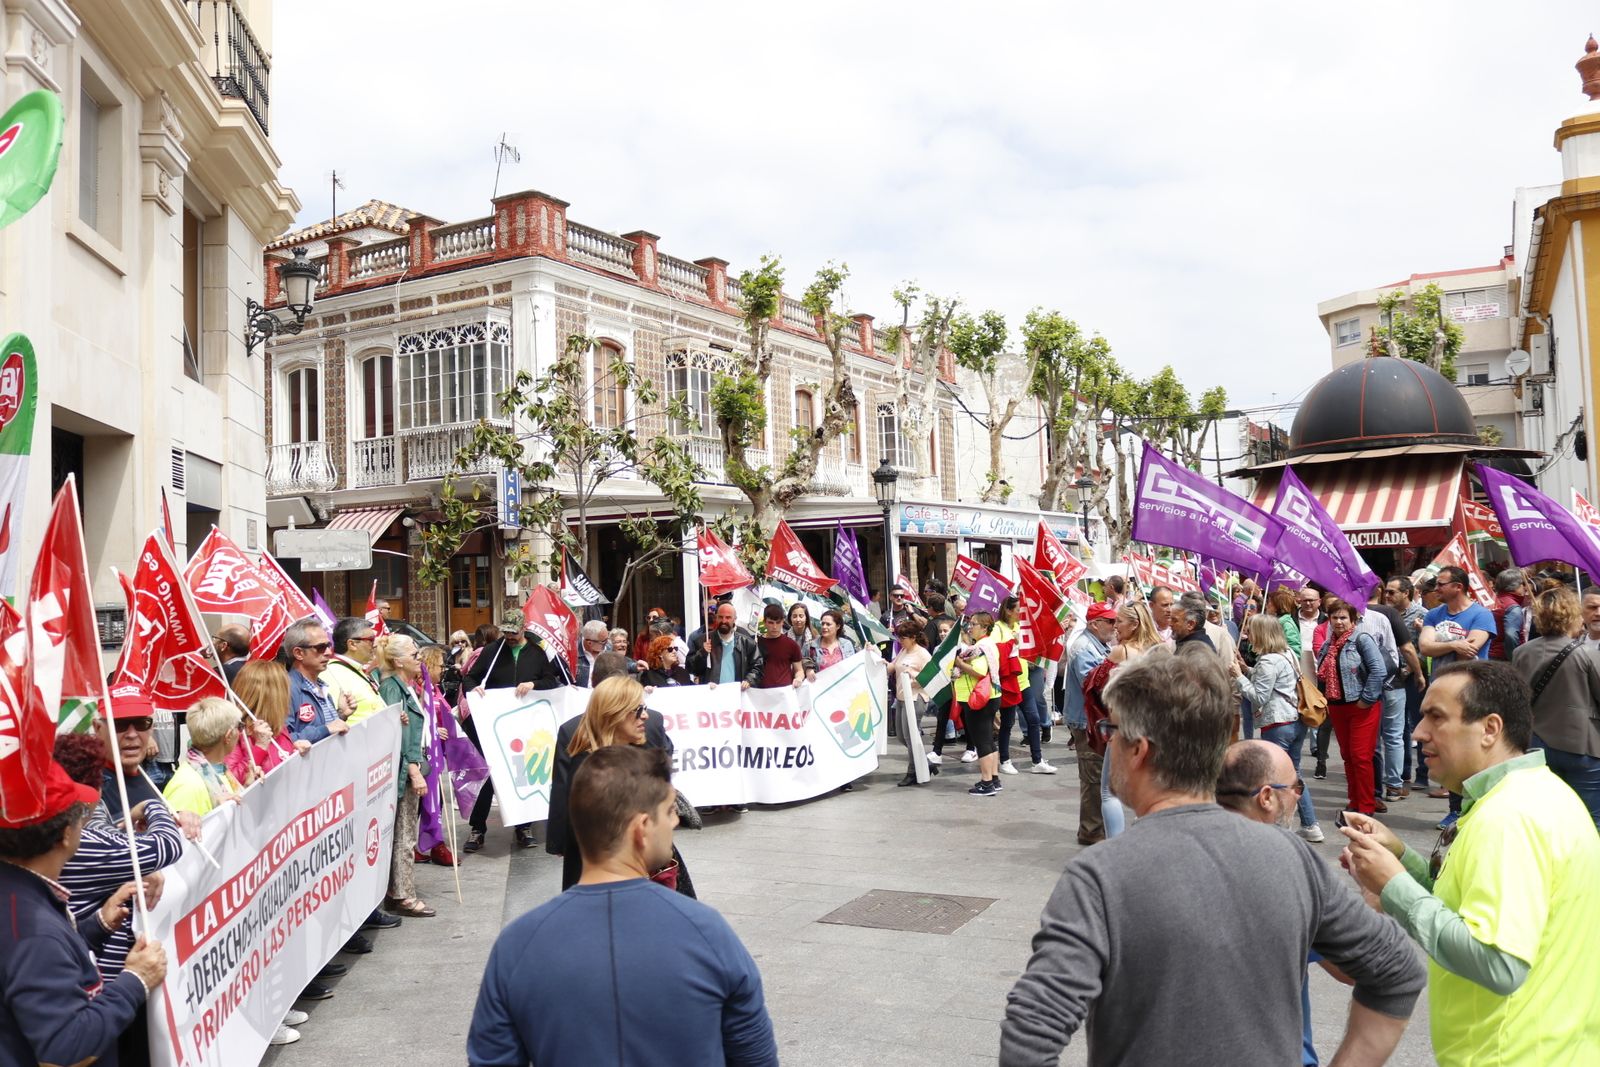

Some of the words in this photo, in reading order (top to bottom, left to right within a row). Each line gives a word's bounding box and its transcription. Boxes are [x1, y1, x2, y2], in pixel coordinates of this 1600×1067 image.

[507, 473, 516, 522] CAFE
[1138, 501, 1187, 517] servicios
[1199, 514, 1209, 524] la
[904, 505, 932, 521] Café
[942, 508, 960, 521] Bar
[965, 511, 981, 533] La
[990, 517, 1035, 537] Parada
[1286, 524, 1311, 543] vicios
[1319, 543, 1329, 554] la
[527, 623, 570, 665] ANDALUC
[189, 900, 218, 947] LA
[220, 850, 271, 920] LUCHA
[272, 794, 346, 866] CONTINÚA
[192, 948, 260, 1064] PRIMERO
[263, 917, 286, 968] LAS
[287, 852, 355, 937] PERSONAS
